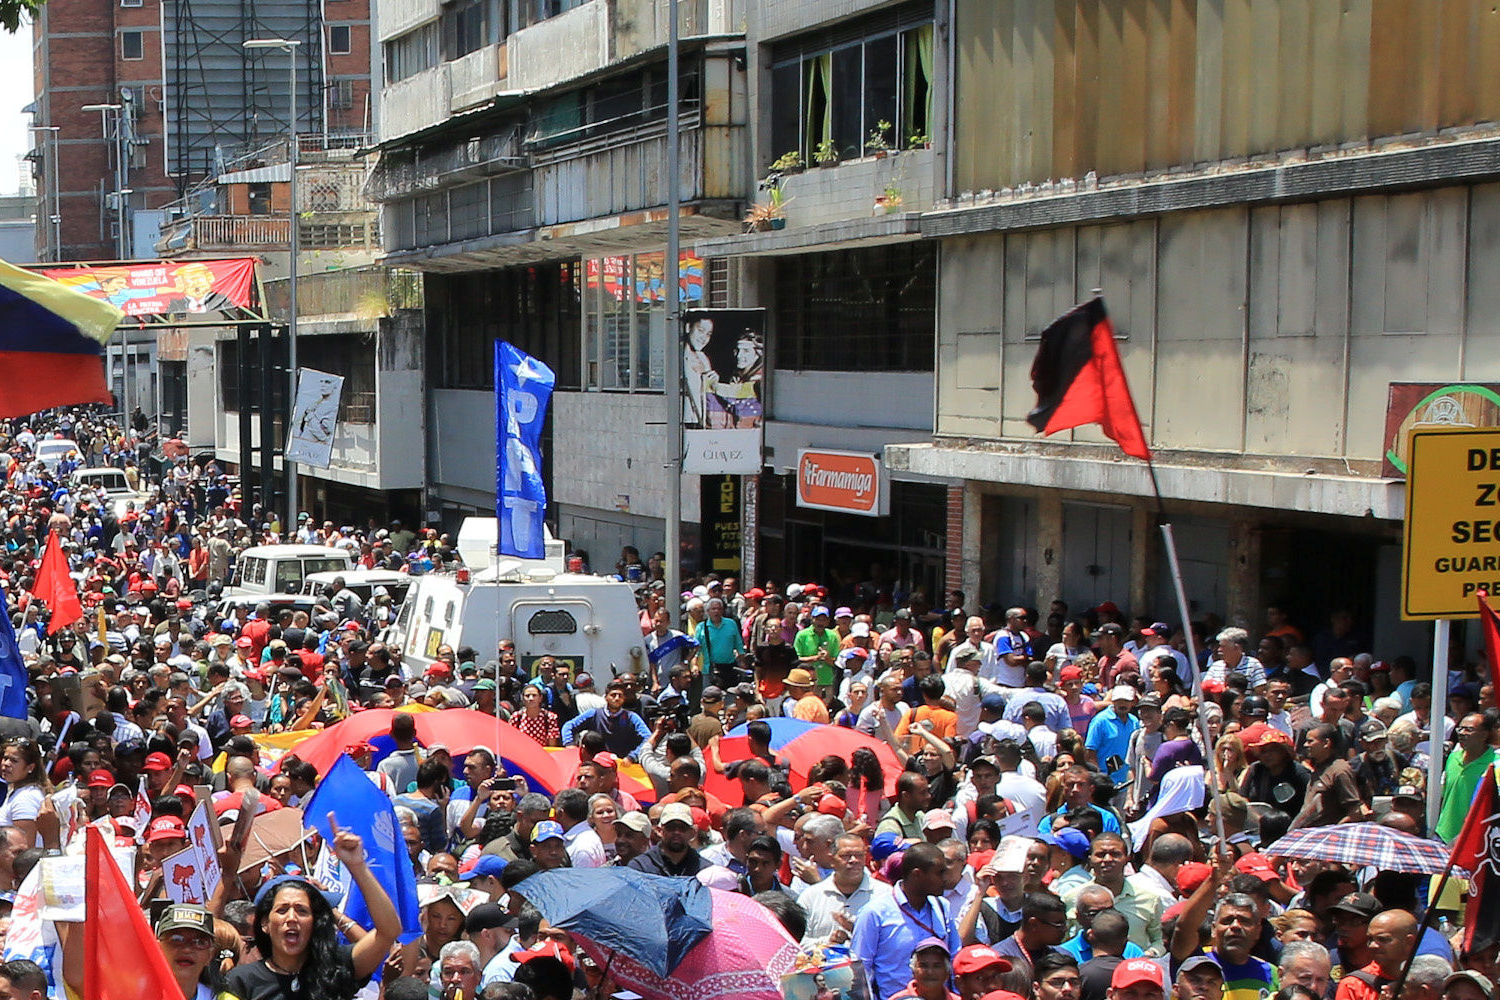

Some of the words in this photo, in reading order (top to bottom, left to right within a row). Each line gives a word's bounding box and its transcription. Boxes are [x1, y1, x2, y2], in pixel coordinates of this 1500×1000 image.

[132, 276, 168, 287] VENEZUELA
[810, 463, 873, 496] Farmamiga
[1475, 484, 1500, 506] Z
[1435, 556, 1500, 573] GUAR
